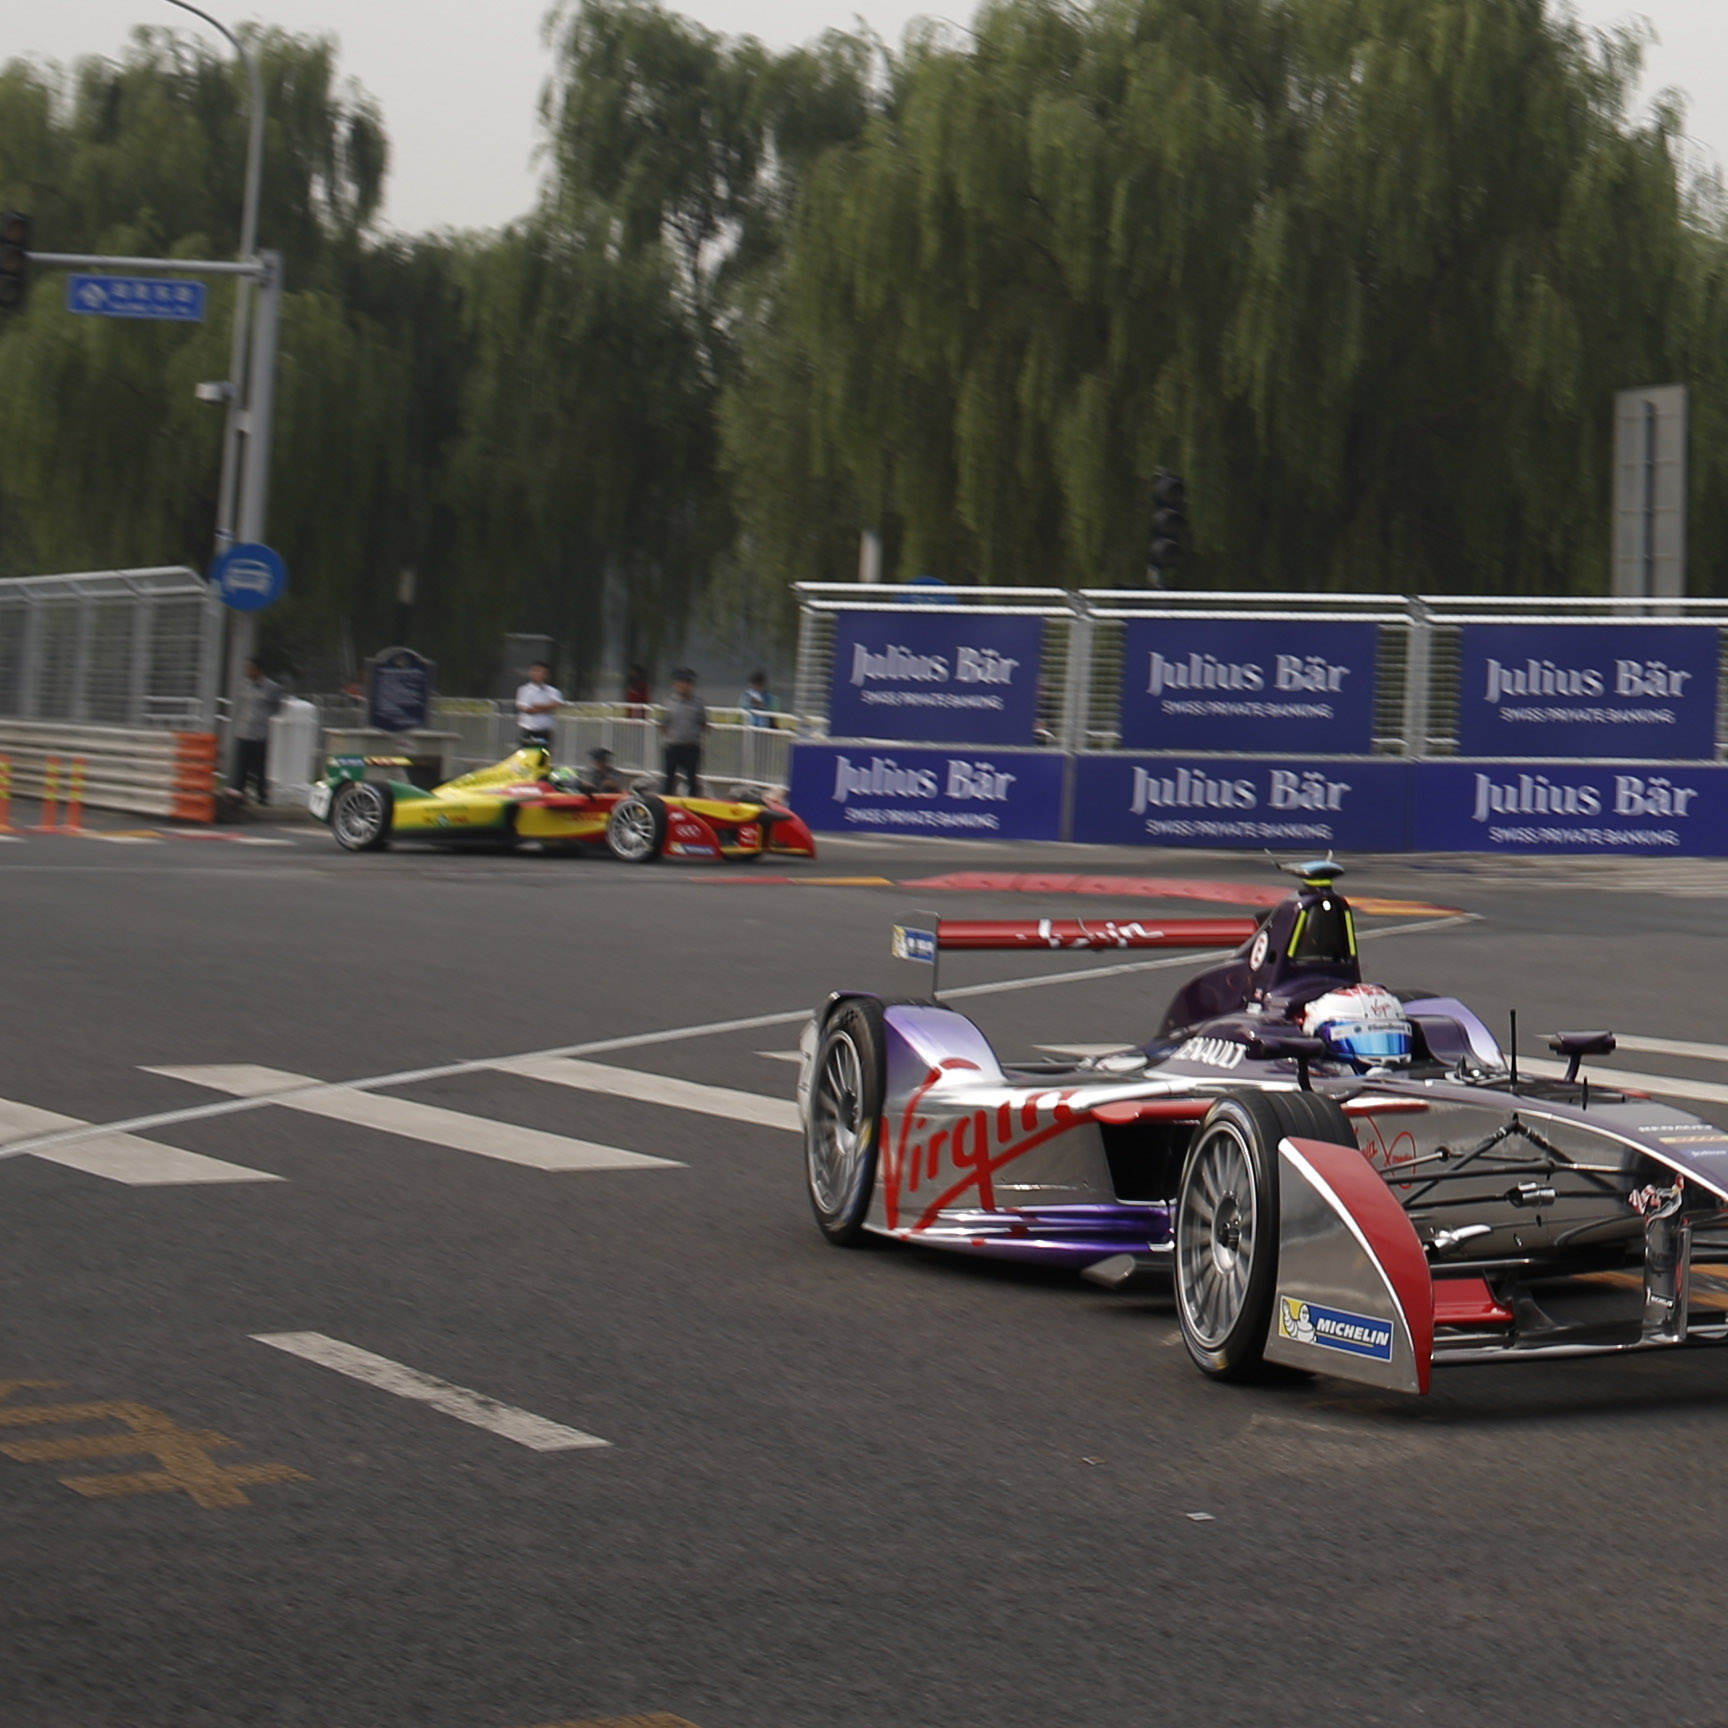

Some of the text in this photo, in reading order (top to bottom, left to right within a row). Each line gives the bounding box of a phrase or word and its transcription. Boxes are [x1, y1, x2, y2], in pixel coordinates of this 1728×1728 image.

[850, 643, 1019, 685] Julius Bär
[1147, 652, 1351, 696] Julius Bär
[1484, 659, 1692, 703] Julius Bär
[832, 756, 1016, 802] Julius Bär
[1130, 766, 1352, 814] Julius Bär
[1472, 773, 1698, 822] Julius Bär
[1316, 1317, 1390, 1347] MICHELIN
